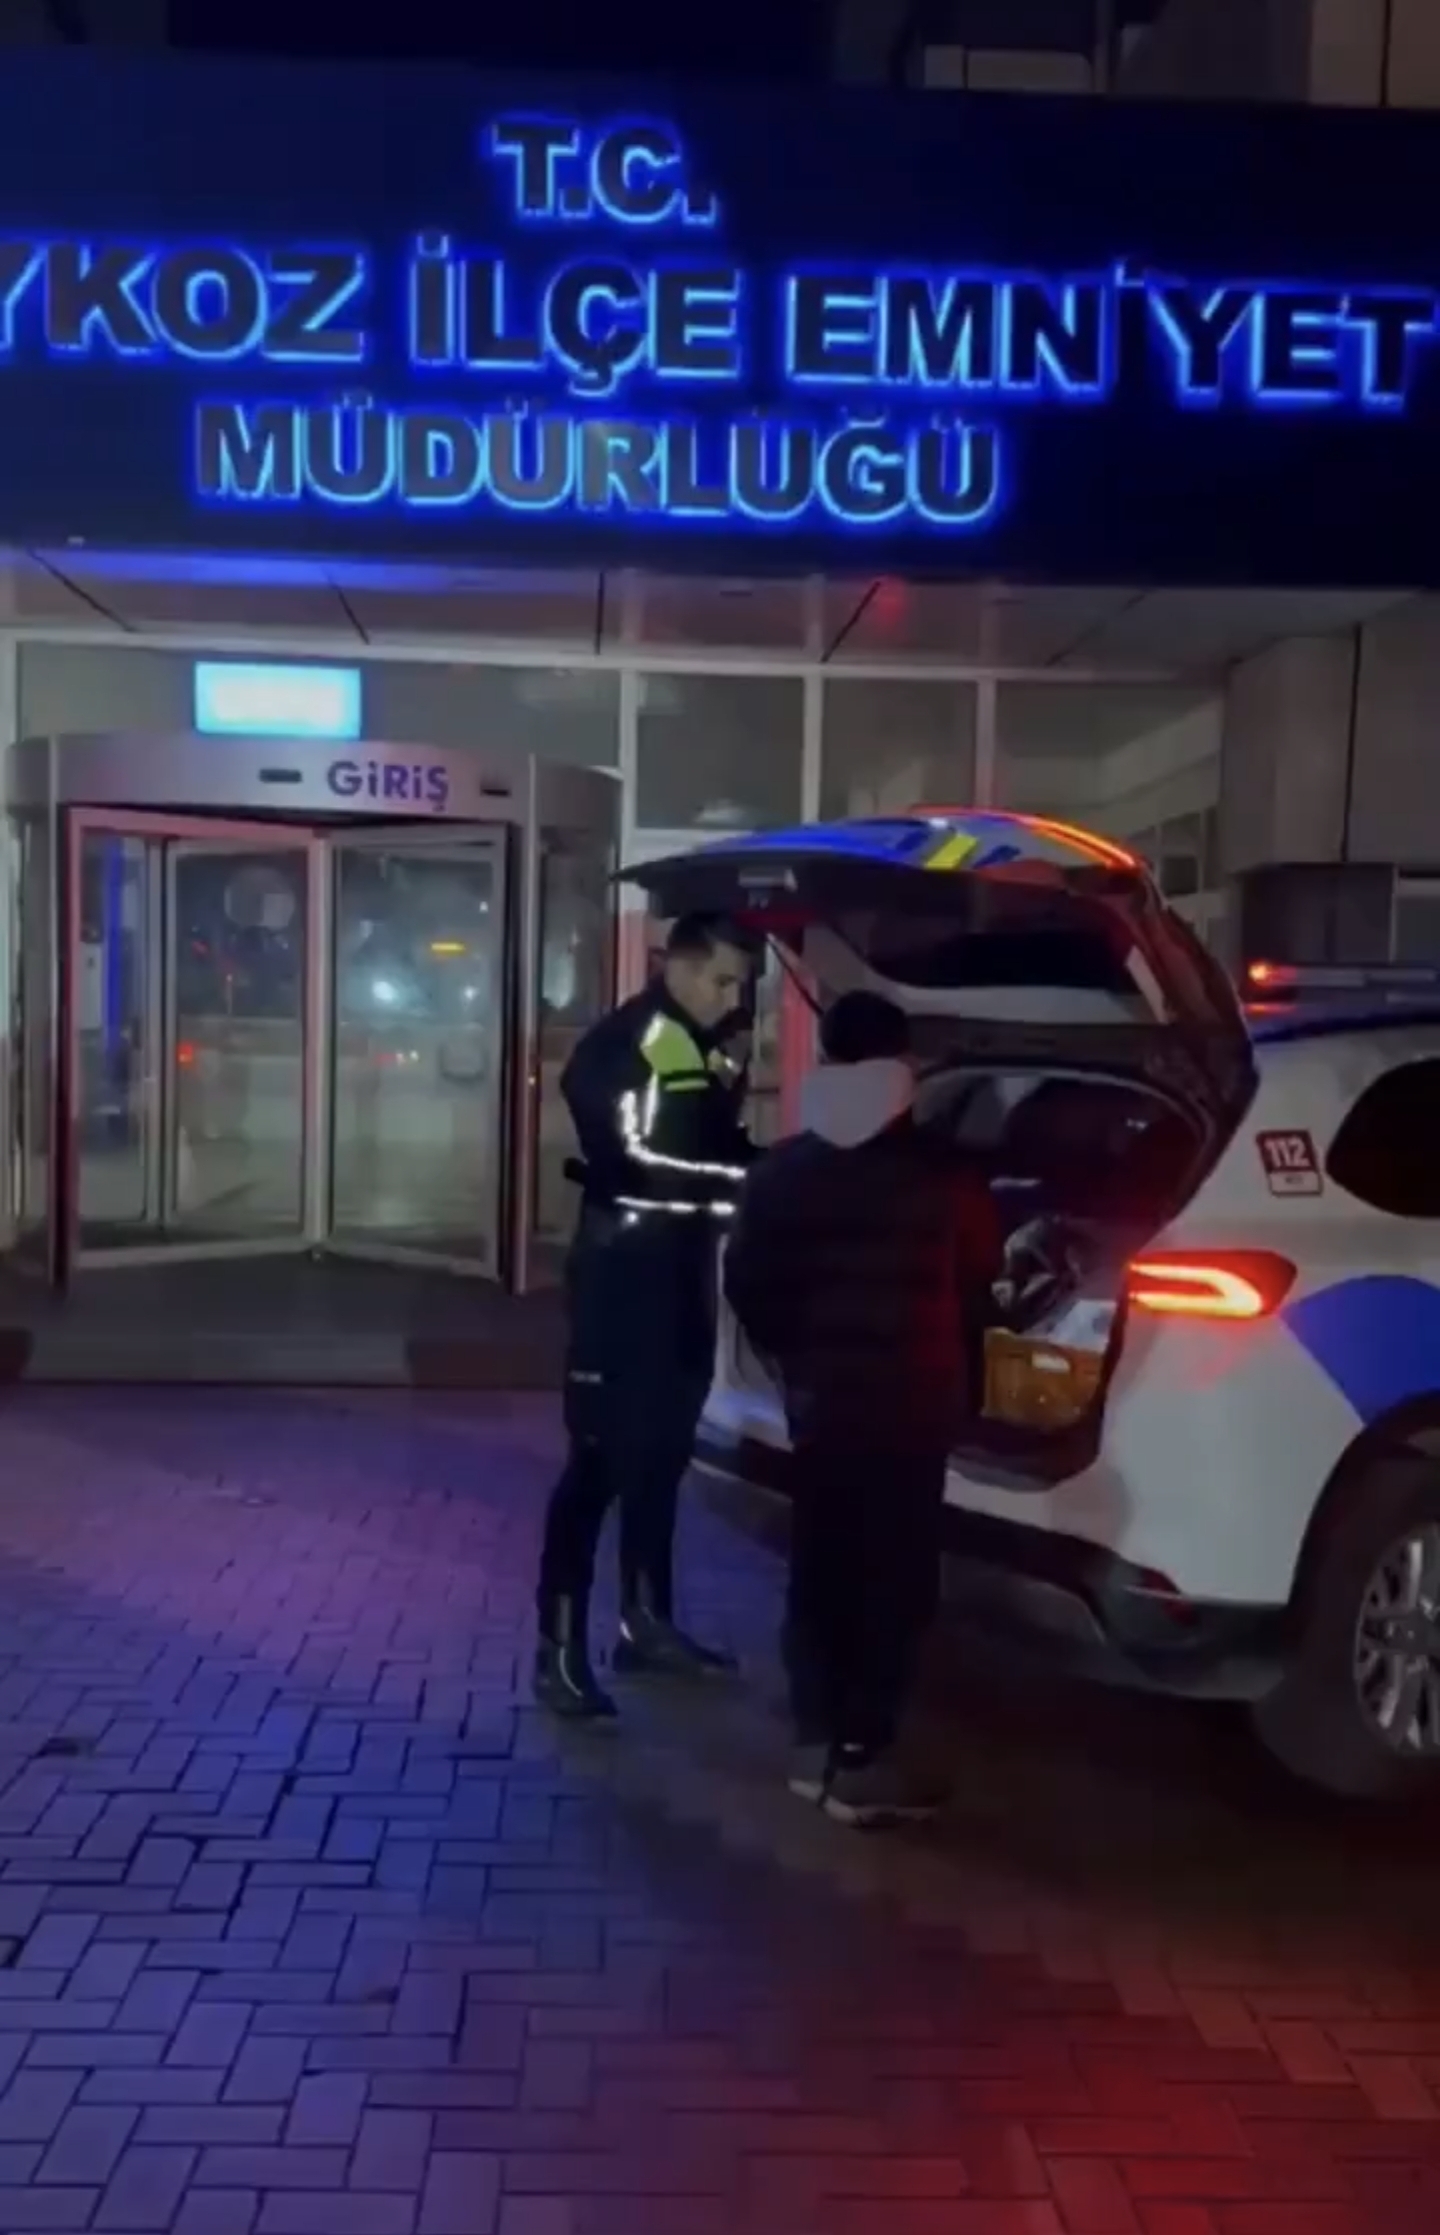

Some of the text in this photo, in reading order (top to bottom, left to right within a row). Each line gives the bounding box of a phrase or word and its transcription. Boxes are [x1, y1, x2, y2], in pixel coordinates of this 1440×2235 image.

[490, 118, 718, 224] T.C.
[408, 233, 742, 396] İLÇE
[195, 392, 1001, 523] MÜDÜRLÜĞÜ
[1264, 1136, 1311, 1167] 112
